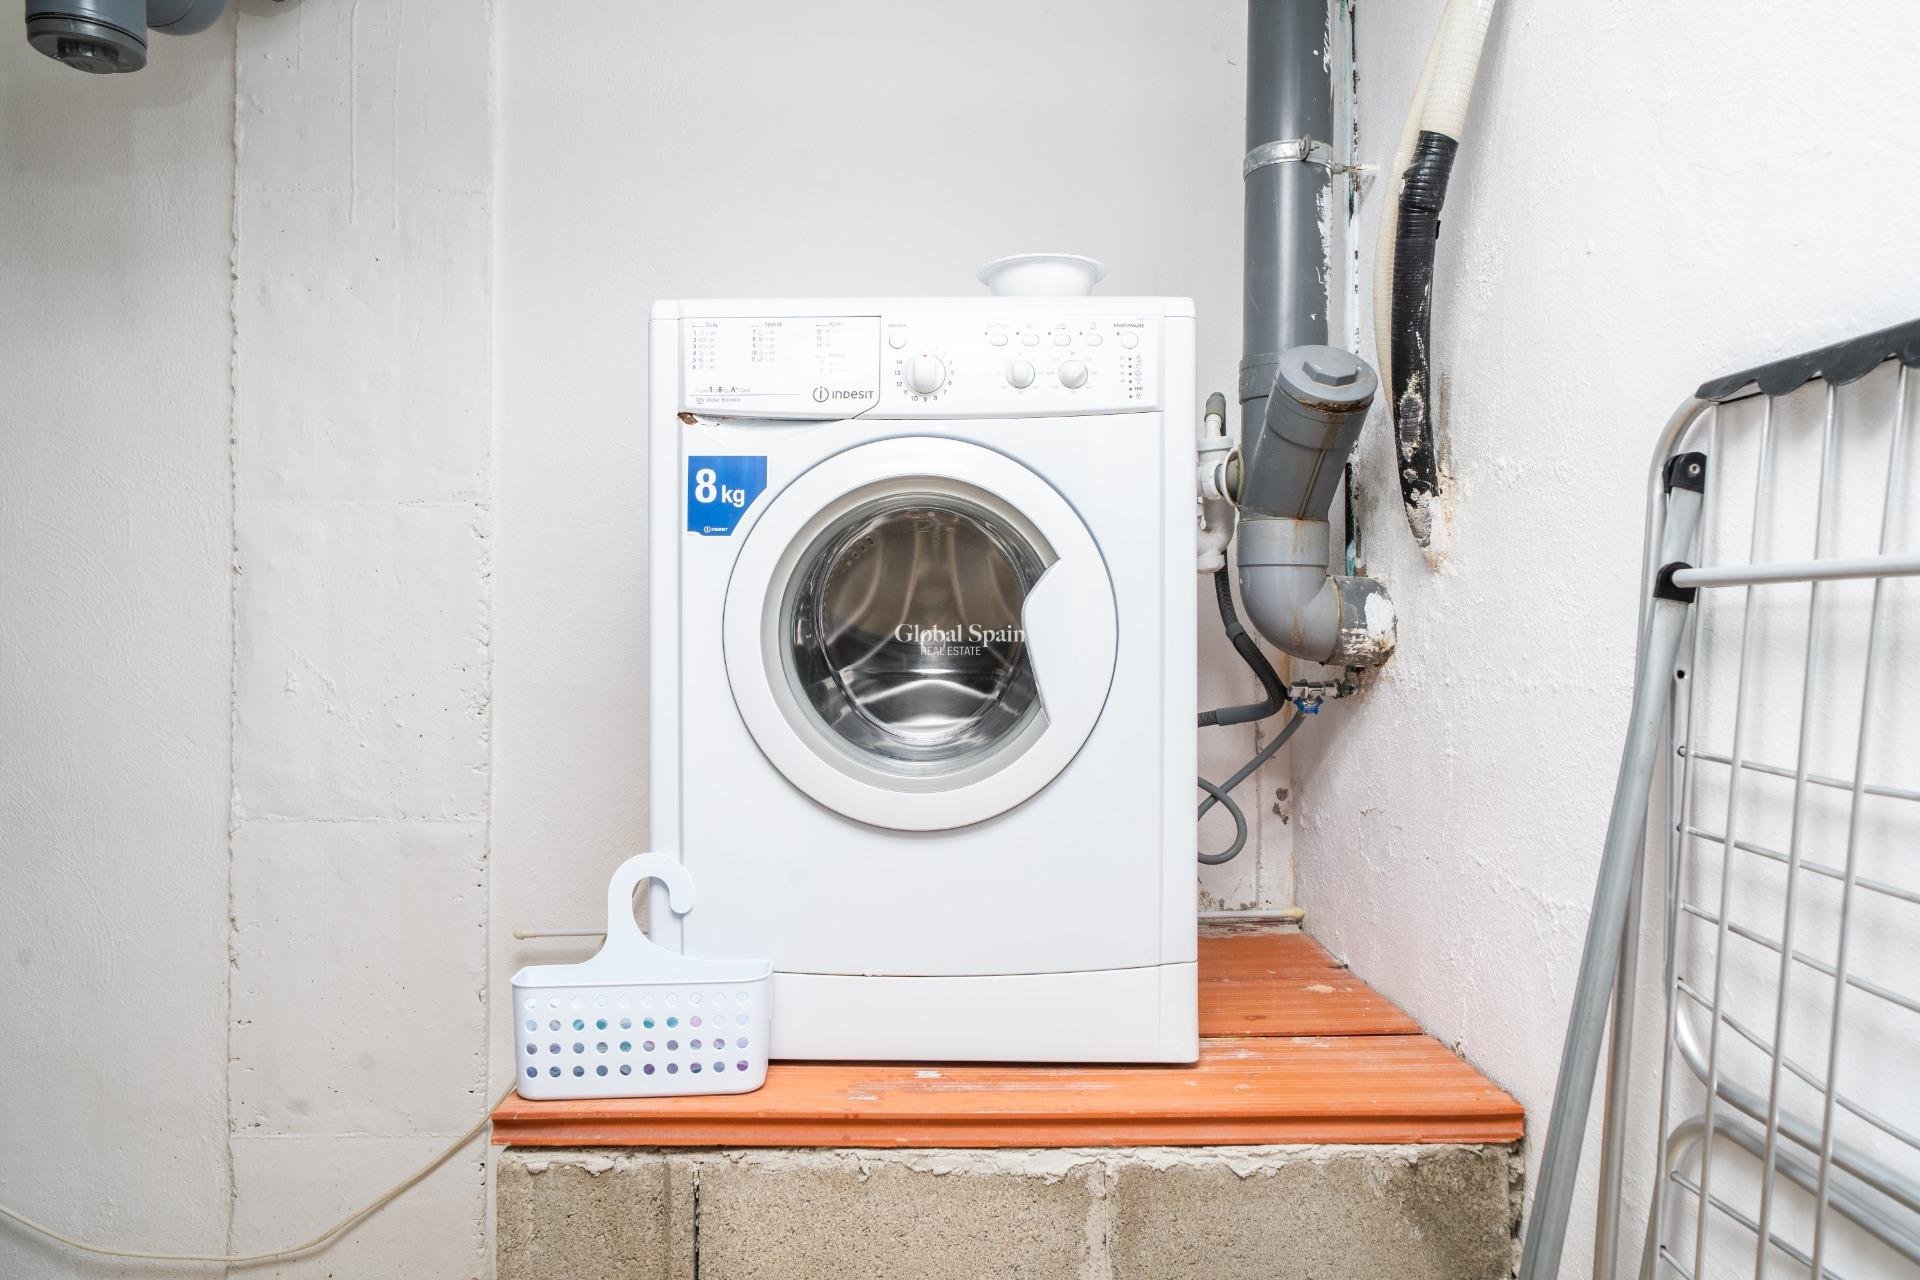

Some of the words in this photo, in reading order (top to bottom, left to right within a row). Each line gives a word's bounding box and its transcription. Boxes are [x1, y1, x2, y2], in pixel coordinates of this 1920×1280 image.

[832, 390, 874, 399] INDESIT
[695, 468, 717, 504] 8
[722, 484, 745, 508] kg
